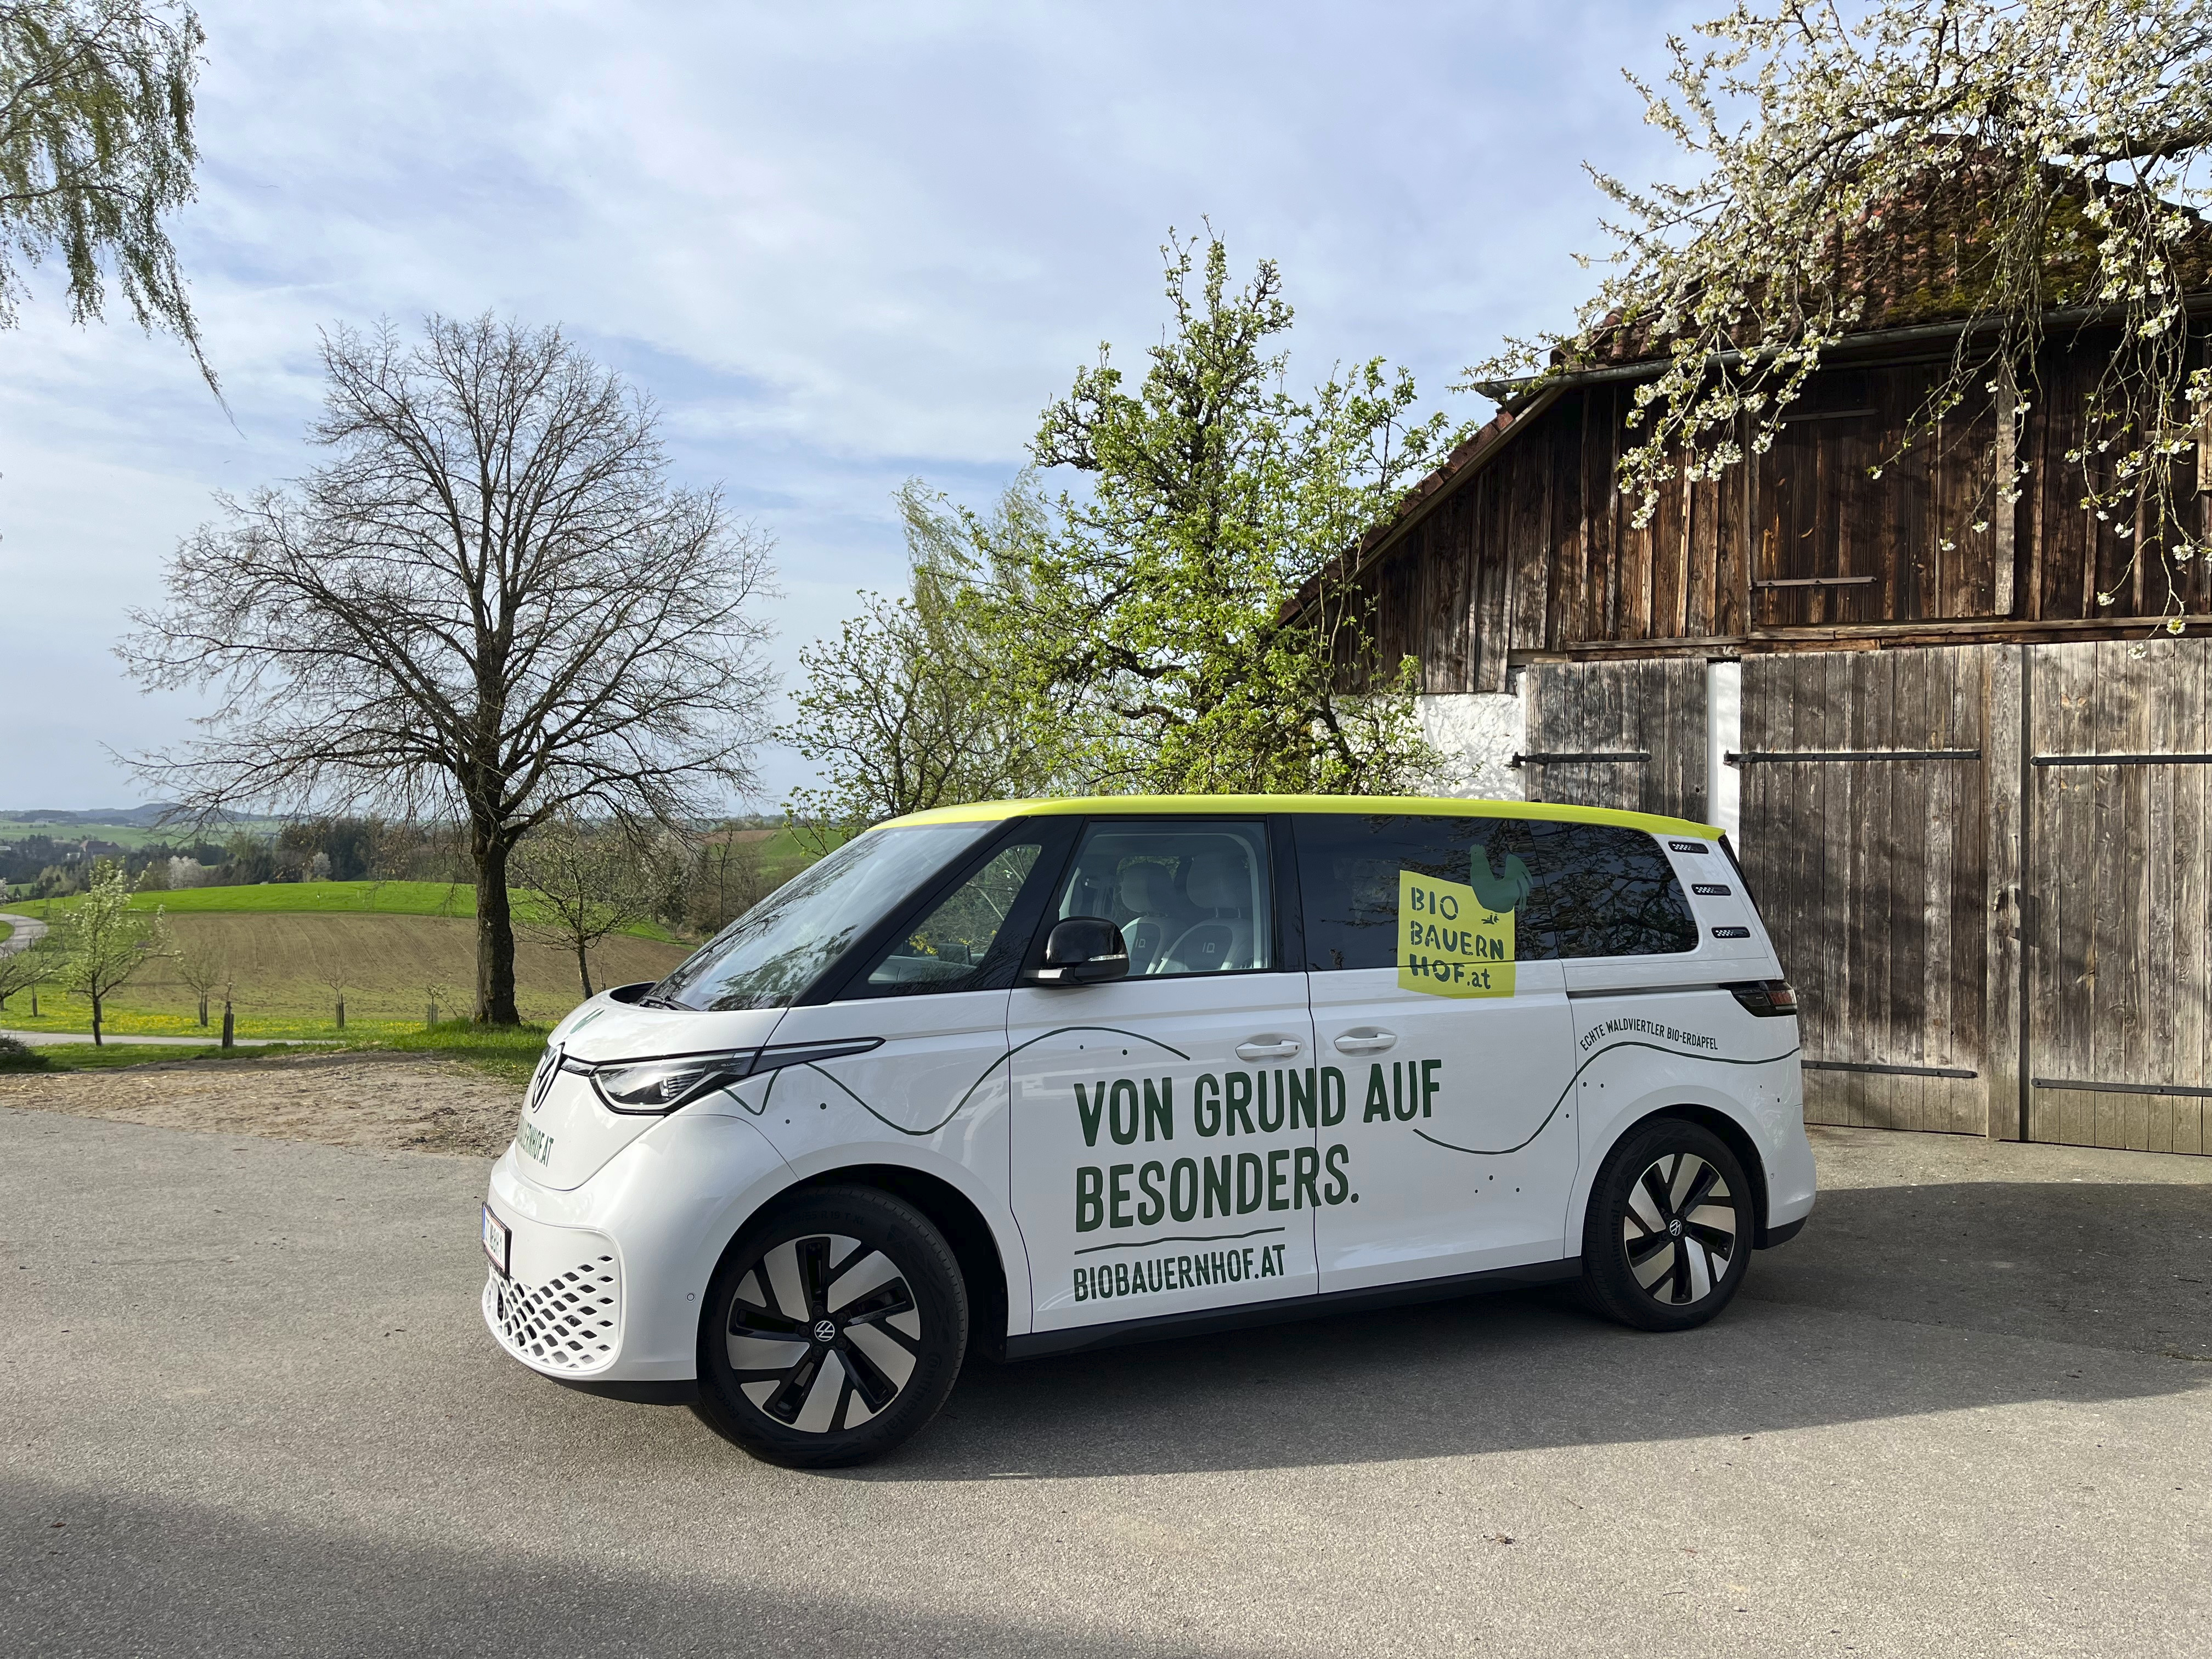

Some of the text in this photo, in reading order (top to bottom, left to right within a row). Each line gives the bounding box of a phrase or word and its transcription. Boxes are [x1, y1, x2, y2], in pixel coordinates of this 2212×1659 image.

[1411, 887, 1459, 921] BIO
[1410, 920, 1504, 960] BAUERN
[1409, 953, 1491, 990] HOF.at
[1579, 1024, 1605, 1051] ECHTE
[1605, 1018, 1664, 1038] WALDVIERTLER
[1073, 1059, 1442, 1148] VON GRUND AUF
[1075, 1144, 1359, 1233] BESONDERS.
[1073, 1244, 1286, 1302] BIOBAUERNHOF.AT
